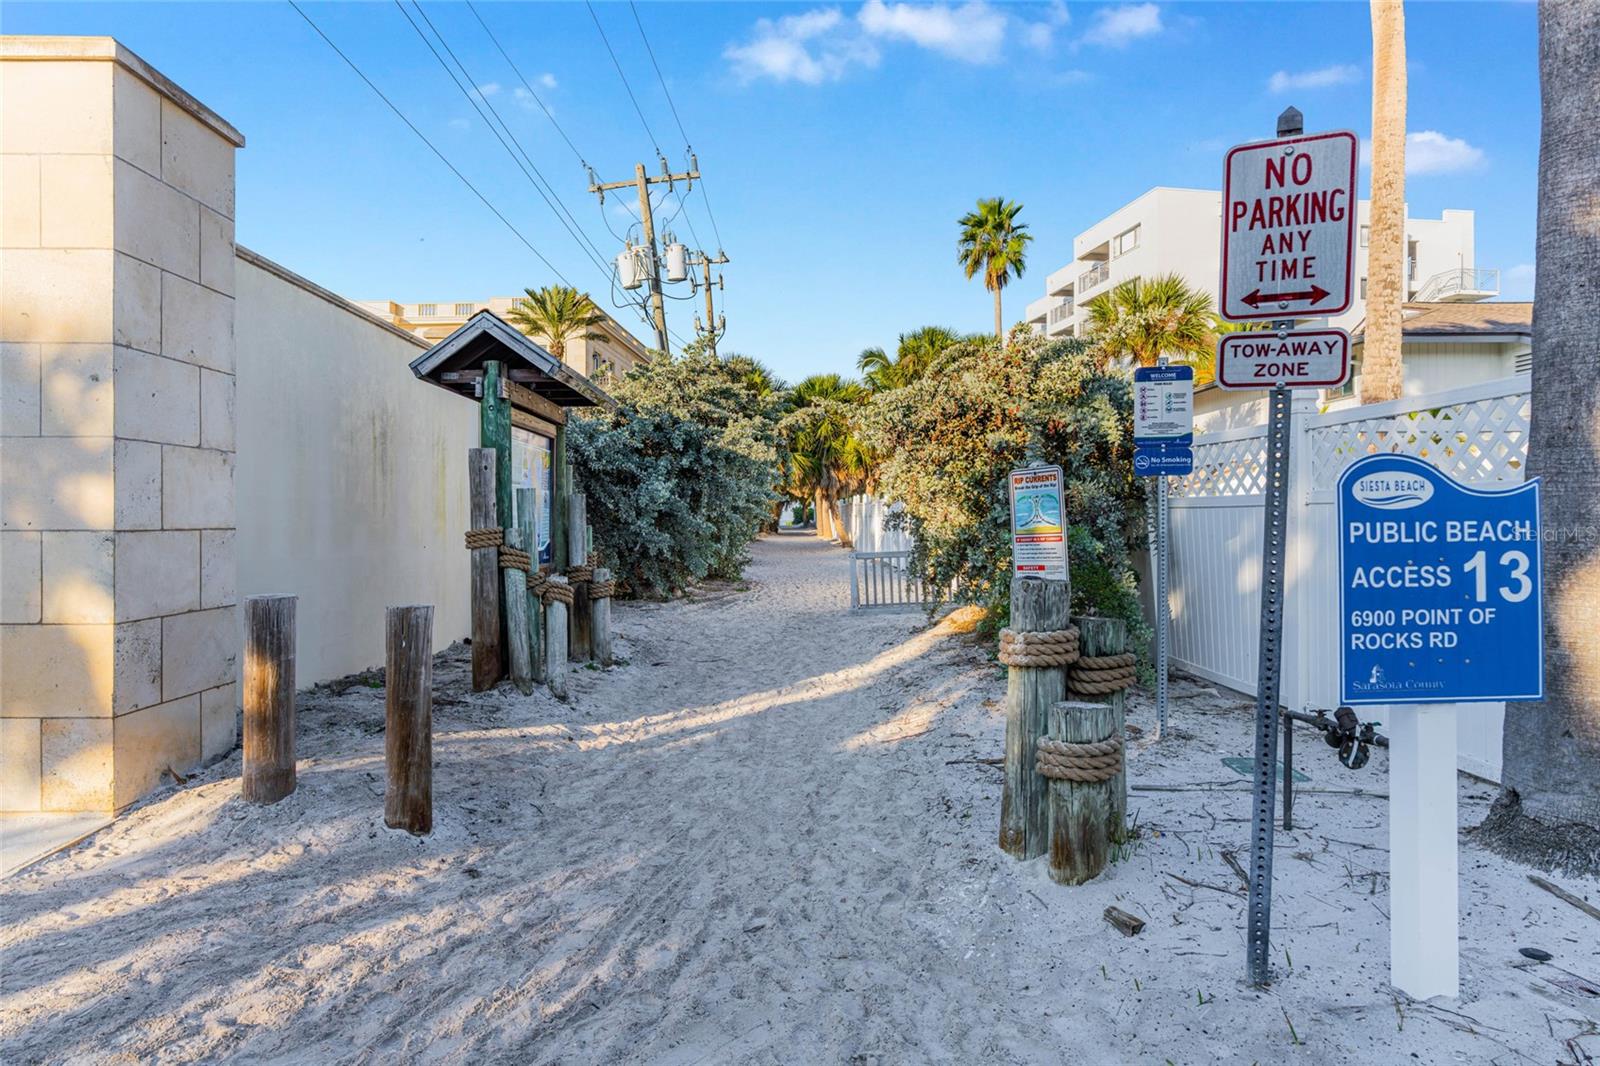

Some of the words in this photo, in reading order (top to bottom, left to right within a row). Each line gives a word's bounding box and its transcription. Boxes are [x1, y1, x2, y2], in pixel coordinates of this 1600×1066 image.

[1265, 152, 1312, 189] NO
[1232, 188, 1345, 232] PARKING
[1261, 230, 1312, 256] ANY
[1255, 256, 1316, 282] TIME
[1230, 340, 1338, 358] TOW-AWAY
[1254, 362, 1309, 377] ZONE
[1161, 456, 1191, 464] Smoking
[1025, 474, 1057, 484] CURRENTS
[1360, 480, 1390, 492] SIESTA
[1394, 480, 1425, 491] BEACH
[1350, 521, 1438, 543] PUBLIC
[1446, 520, 1531, 543] BEACH
[1351, 565, 1451, 588] ACCESS
[1463, 550, 1533, 603] 13
[1351, 610, 1395, 627] 6900
[1402, 608, 1463, 625] POINT
[1468, 608, 1496, 624] OF
[1351, 632, 1423, 650] ROCKS
[1429, 631, 1458, 648] RD
[1352, 679, 1402, 690] Sarasota
[1405, 680, 1446, 690] County
